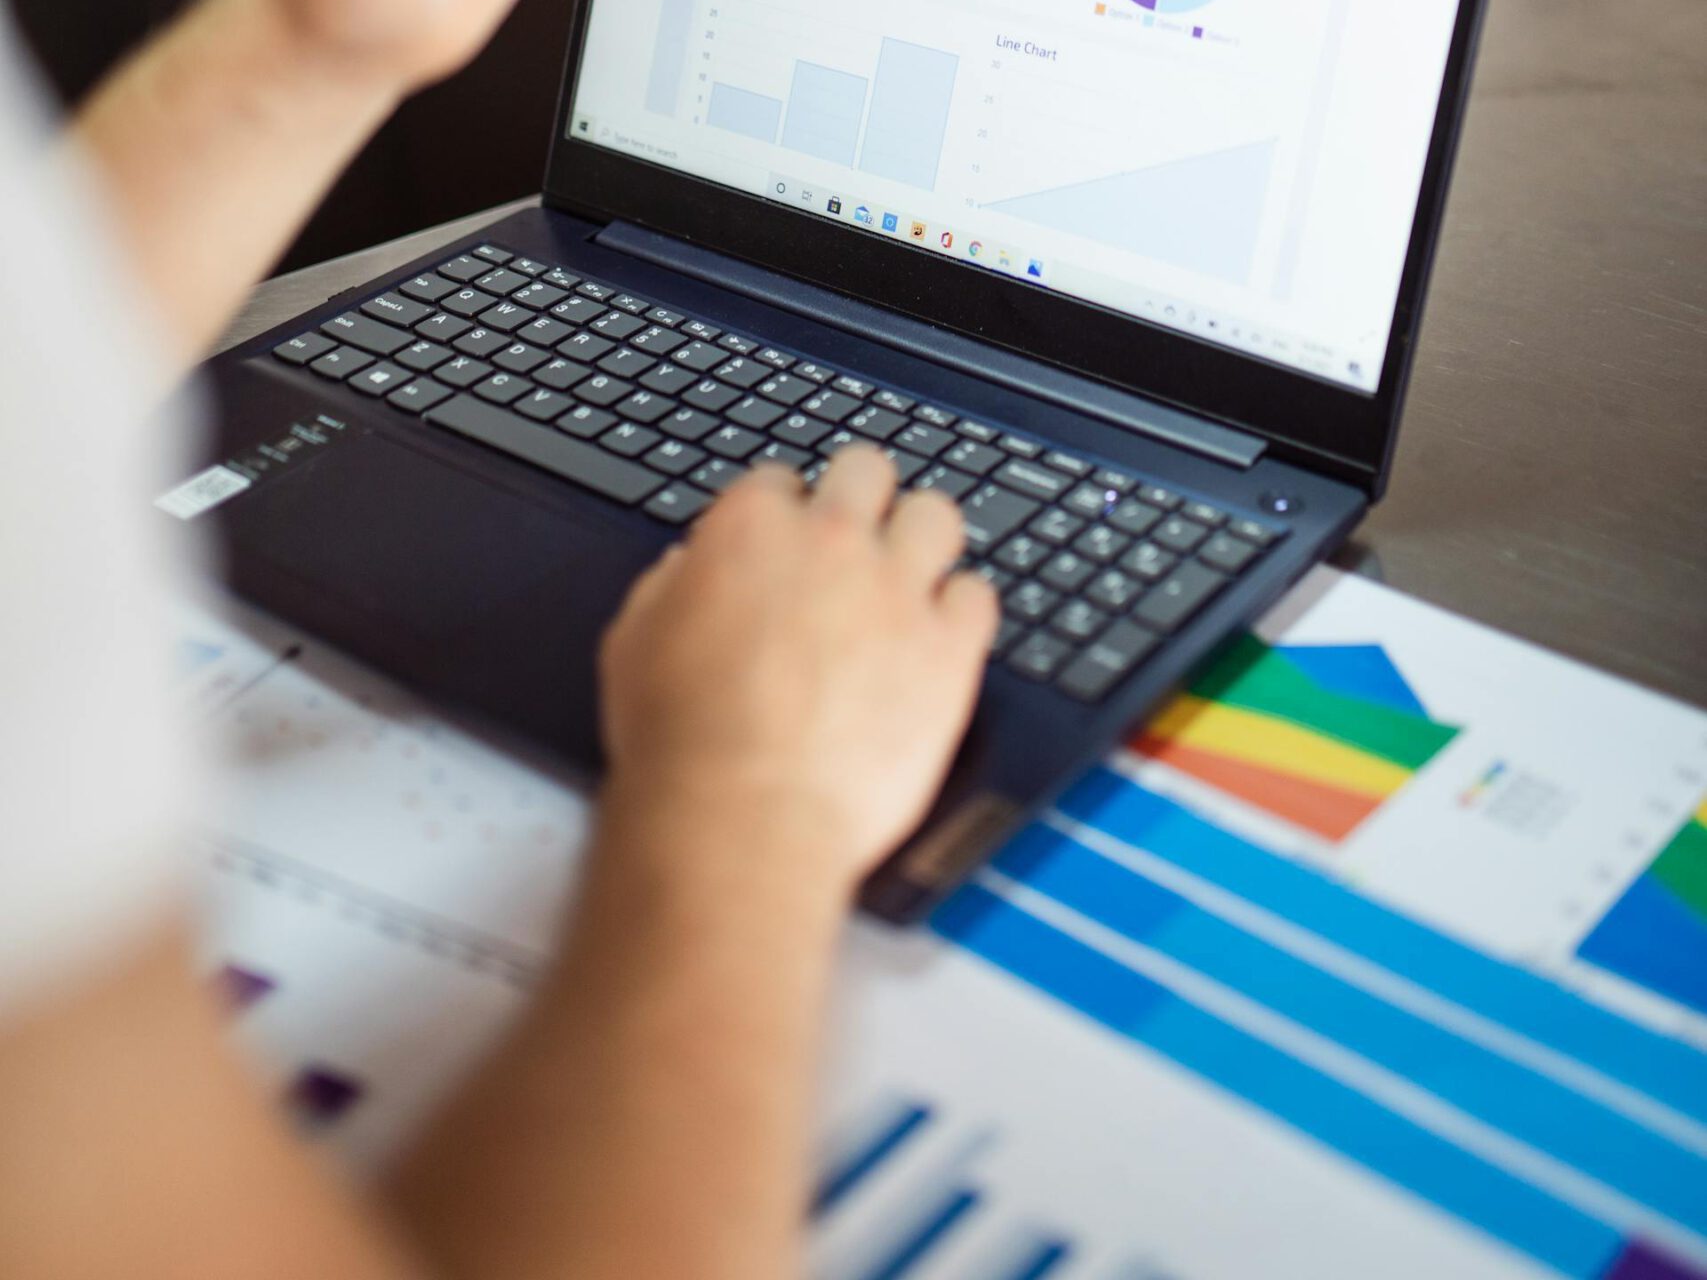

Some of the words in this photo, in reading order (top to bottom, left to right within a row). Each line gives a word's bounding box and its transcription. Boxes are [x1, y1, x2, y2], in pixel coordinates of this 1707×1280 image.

[995, 33, 1021, 52] Line
[1024, 41, 1058, 62] Chart
[964, 197, 975, 208] 10
[413, 277, 429, 287] Tab
[459, 290, 475, 300] Q
[516, 290, 530, 299] 2
[374, 297, 404, 312] CapsLk
[497, 303, 517, 315] W
[556, 304, 569, 313] 3
[431, 314, 448, 325] A
[533, 319, 551, 329] E
[596, 319, 609, 329] 4
[470, 329, 486, 340] S
[573, 334, 590, 345] R
[635, 334, 649, 344] 5
[411, 342, 430, 353] Z
[508, 344, 526, 355] D
[616, 349, 632, 360] T
[676, 350, 690, 359] 6
[450, 358, 470, 369] X
[548, 359, 567, 370] F
[658, 364, 674, 376] Y
[719, 366, 734, 375] 7
[492, 374, 510, 386] C
[591, 376, 609, 389] G
[698, 381, 718, 393] U
[533, 390, 552, 402] V
[631, 391, 652, 406] H
[741, 398, 755, 409] I
[572, 406, 592, 420] B
[675, 408, 694, 422] J
[788, 415, 807, 428] O
[615, 423, 637, 438] N
[719, 425, 740, 441] K
[659, 440, 684, 457] M
